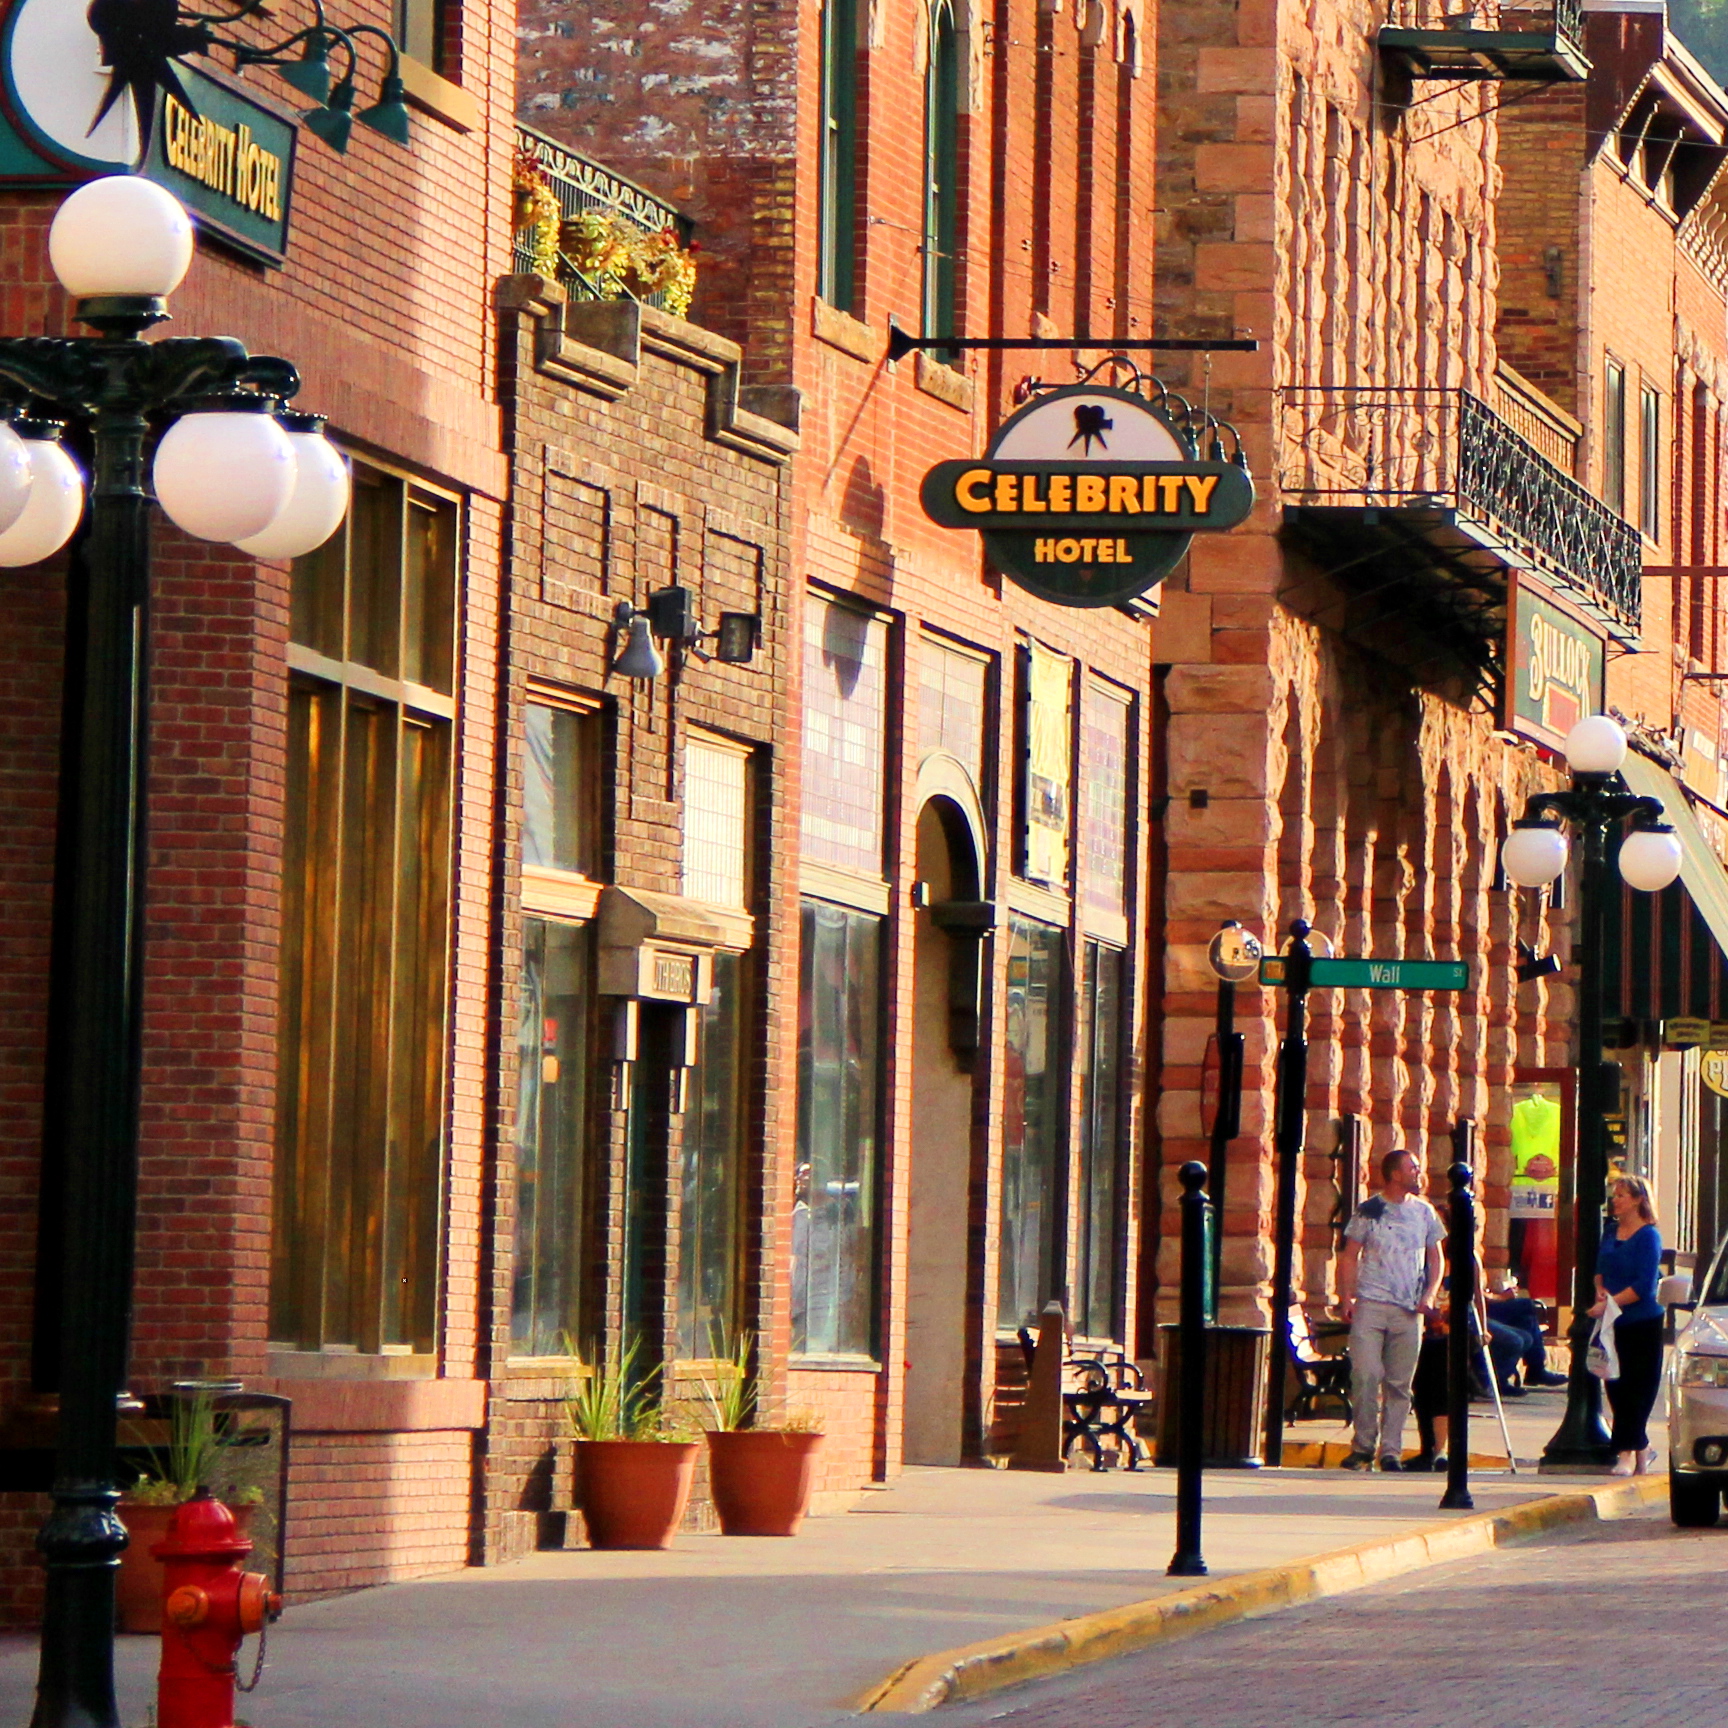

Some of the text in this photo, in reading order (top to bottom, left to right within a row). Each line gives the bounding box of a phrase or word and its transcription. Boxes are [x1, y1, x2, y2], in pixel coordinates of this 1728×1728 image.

[165, 92, 282, 222] CELEBRITY HOTEL
[955, 469, 1218, 514] CELEBRITY
[1034, 538, 1133, 563] HOTEL
[1529, 612, 1592, 719] BULLOCK
[1369, 964, 1400, 983] Wall
